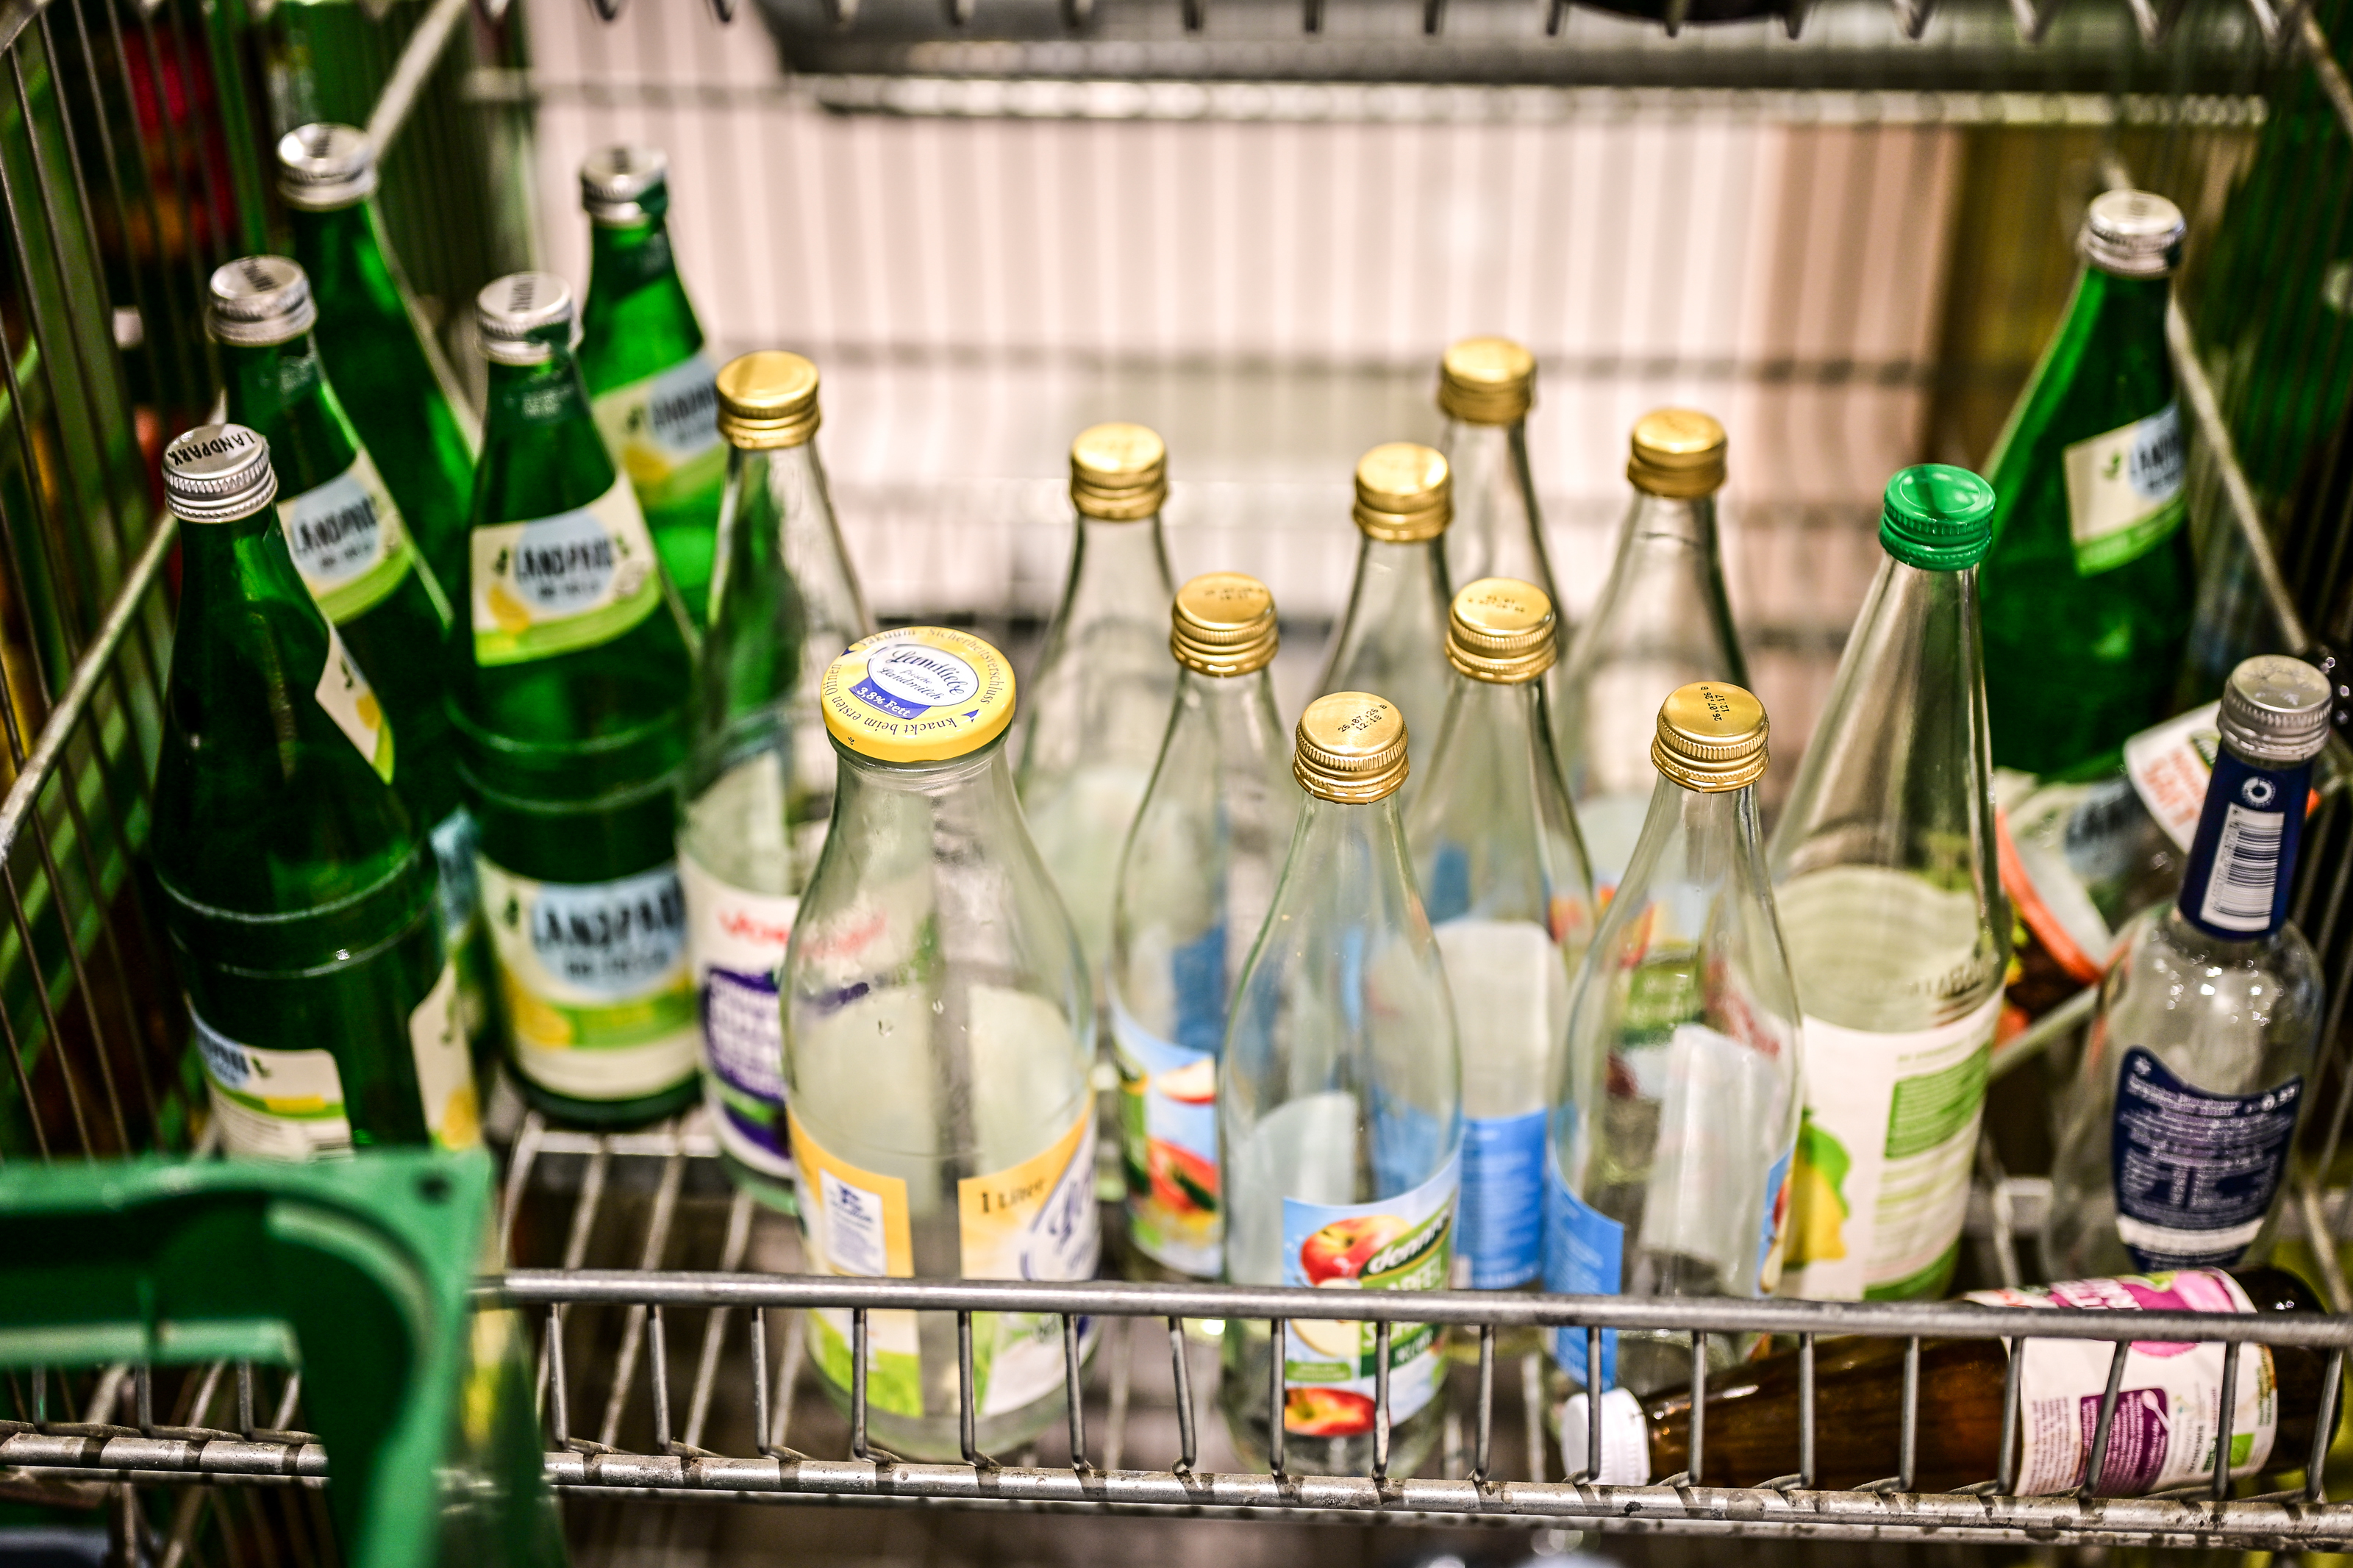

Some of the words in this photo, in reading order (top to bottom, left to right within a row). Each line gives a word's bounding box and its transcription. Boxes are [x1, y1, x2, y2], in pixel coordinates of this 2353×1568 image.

[168, 431, 255, 466] LANDPARK
[857, 629, 915, 647] Vakuum
[928, 628, 1004, 704] Sicherheitsverschluss
[885, 650, 968, 695] Landliebe
[900, 669, 932, 684] frische
[823, 664, 842, 698] Öffnen
[877, 667, 941, 700] Landmilch
[832, 696, 862, 721] ersten
[857, 687, 884, 706] 3,8%
[884, 700, 910, 717] Fett
[1715, 694, 1730, 712] 12:17
[864, 717, 899, 735] beim
[904, 717, 957, 735] knackt
[982, 1191, 990, 1213] 1
